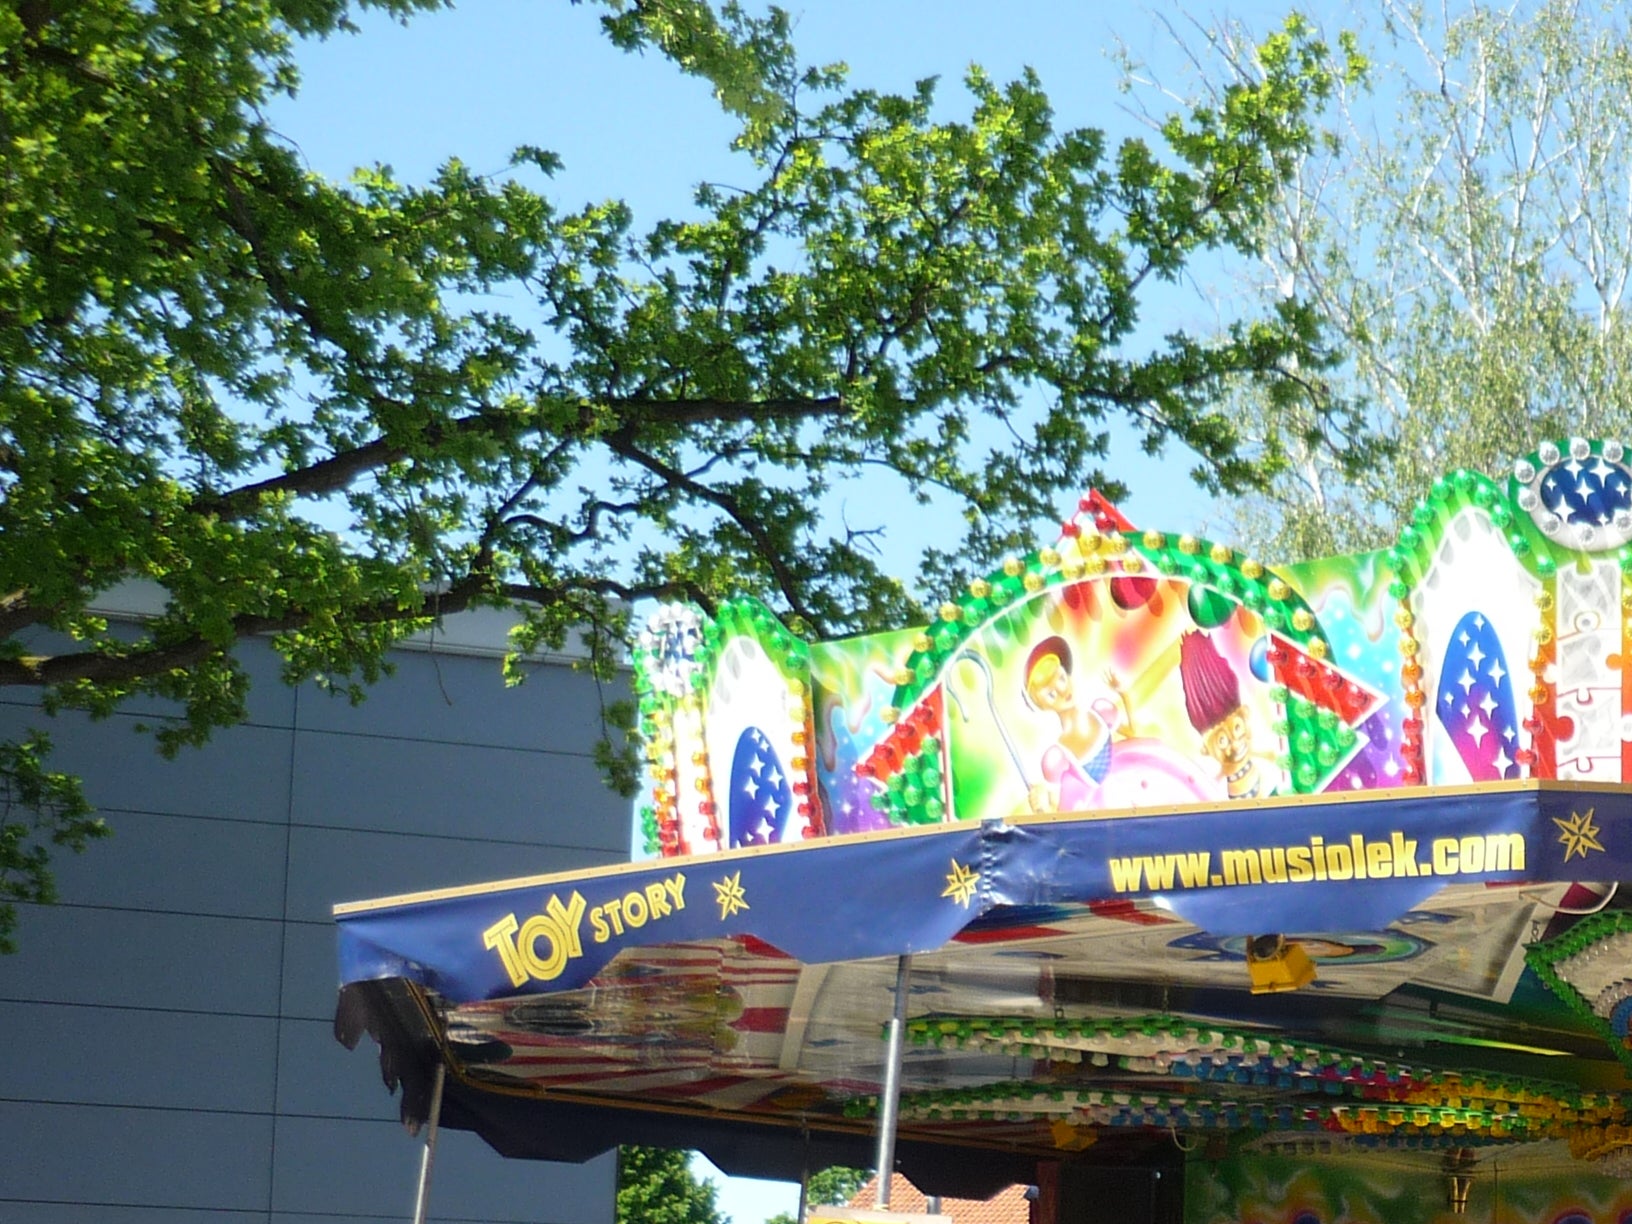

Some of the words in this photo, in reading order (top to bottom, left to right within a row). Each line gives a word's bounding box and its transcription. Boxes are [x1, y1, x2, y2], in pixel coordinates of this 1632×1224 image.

[1110, 832, 1526, 892] www.musiolek.com
[483, 890, 587, 988] TOY
[590, 872, 686, 943] STORY
